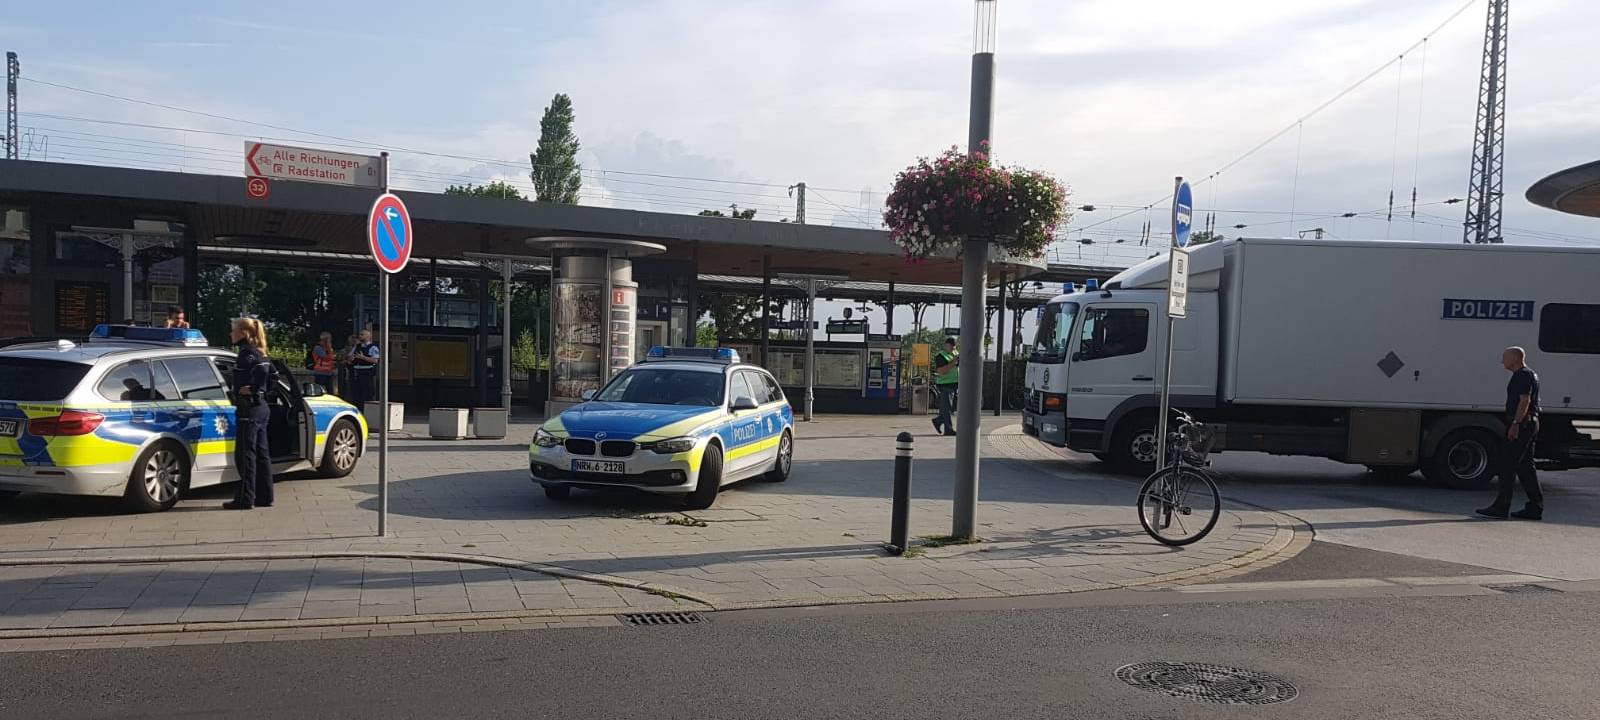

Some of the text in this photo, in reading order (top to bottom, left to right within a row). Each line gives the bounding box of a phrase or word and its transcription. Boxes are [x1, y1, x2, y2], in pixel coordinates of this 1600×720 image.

[273, 150, 360, 169] Alle Richtungen
[288, 165, 345, 180] Radstation
[251, 183, 264, 193] 32
[1451, 301, 1525, 318] POLIZEI
[733, 422, 756, 442] POLIZEI
